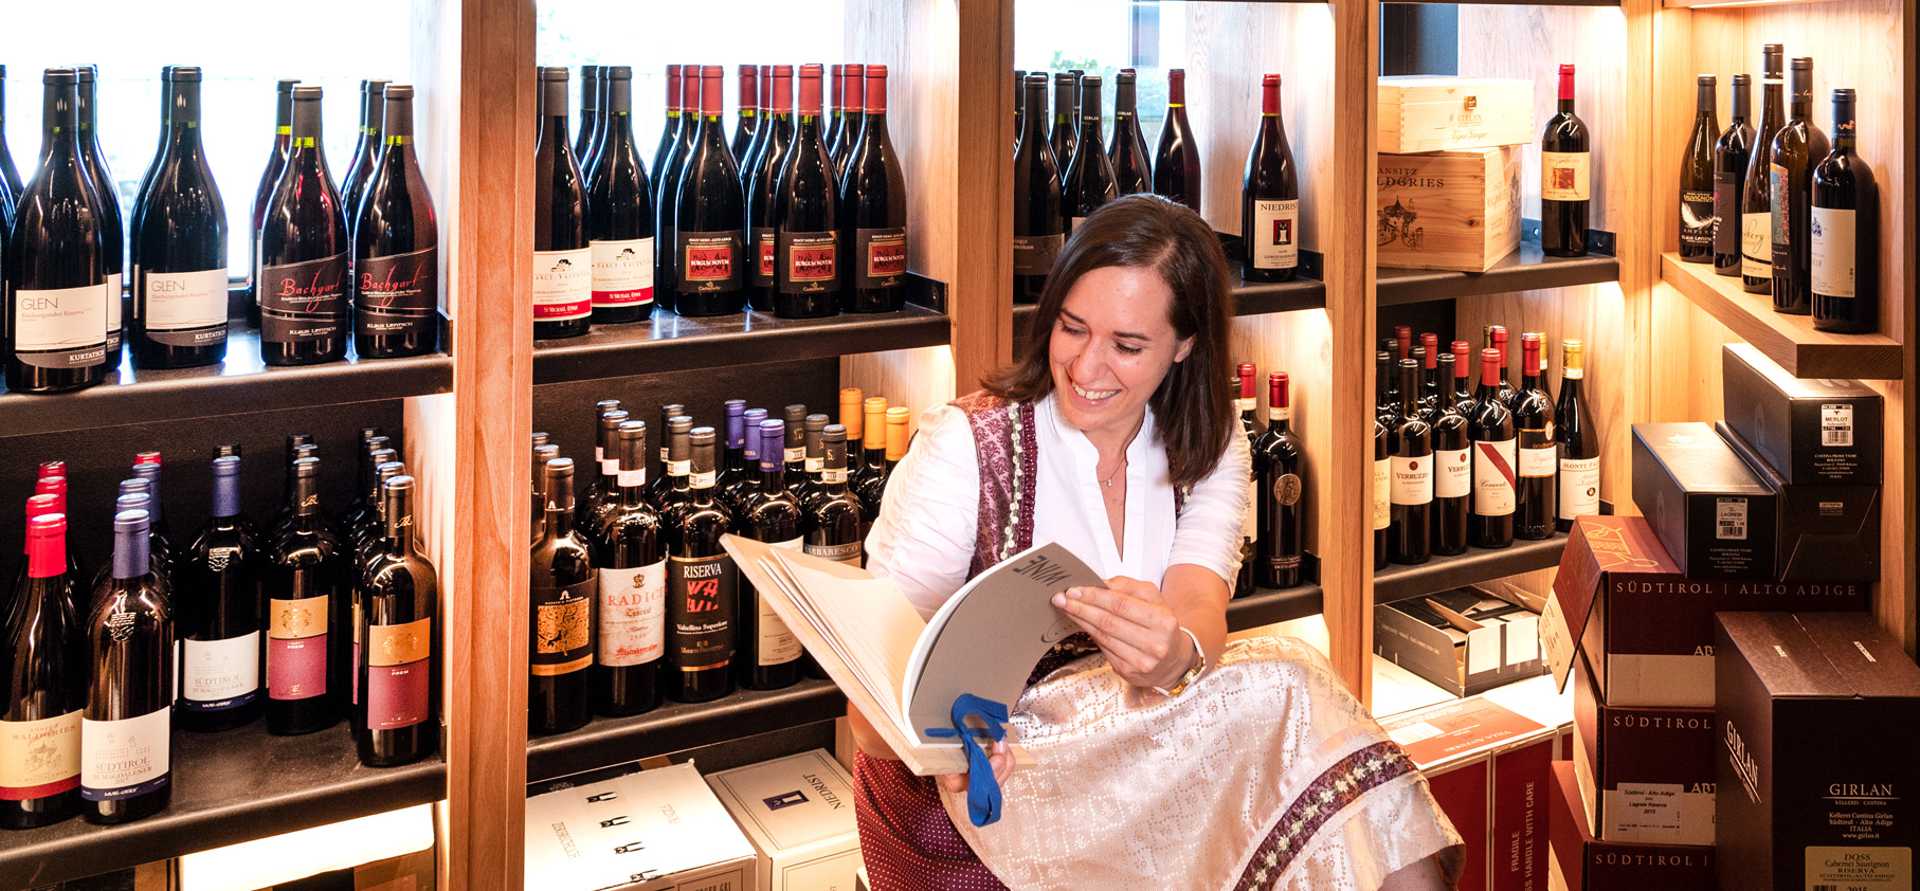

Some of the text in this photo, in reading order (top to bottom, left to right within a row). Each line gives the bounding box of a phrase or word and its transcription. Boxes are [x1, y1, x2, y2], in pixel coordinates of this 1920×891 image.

[151, 280, 185, 292] GLEN
[21, 297, 58, 310] GLEN
[683, 562, 722, 578] RISERVA
[1013, 555, 1073, 587] WINE
[1616, 581, 1857, 597] SÜDTIROL ALTO ADIGE
[1612, 714, 1712, 730] SÜDTIROL
[1726, 719, 1759, 791] GIRLAN
[801, 773, 847, 812] NIEDRIST
[1526, 781, 1535, 808] CARE
[1829, 783, 1894, 797] GIRLAN
[1525, 809, 1534, 837] WITH
[1849, 825, 1873, 833] ITALIA
[1524, 839, 1534, 878] HANDLE
[1595, 852, 1694, 867] SÜDTIROL
